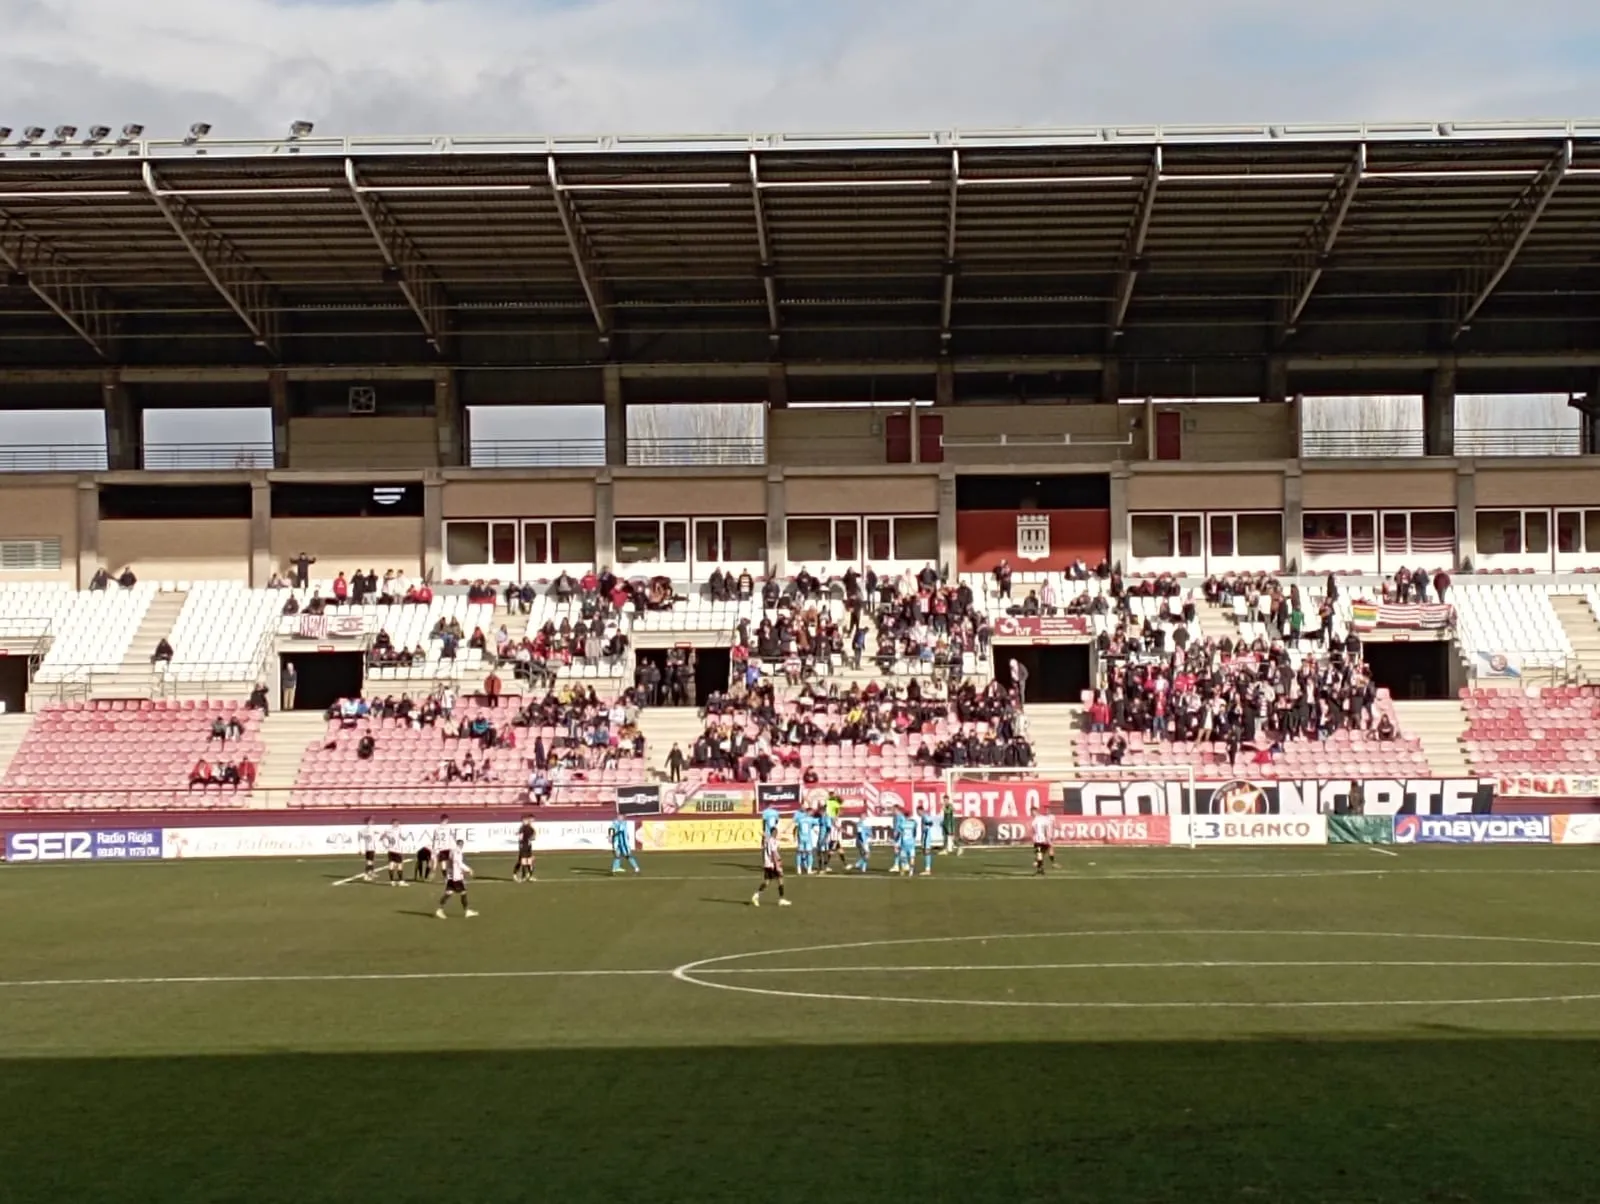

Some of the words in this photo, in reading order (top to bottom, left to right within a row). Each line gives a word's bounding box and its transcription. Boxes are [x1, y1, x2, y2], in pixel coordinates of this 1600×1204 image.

[912, 790, 1019, 817] PUERTA
[97, 832, 126, 844] Radio
[128, 831, 153, 845] Rioja
[997, 823, 1026, 840] SD
[1055, 819, 1148, 840] GROÑÉS
[1224, 822, 1310, 837] BLANCO
[1421, 816, 1550, 842] mayoral
[11, 831, 92, 861] SER
